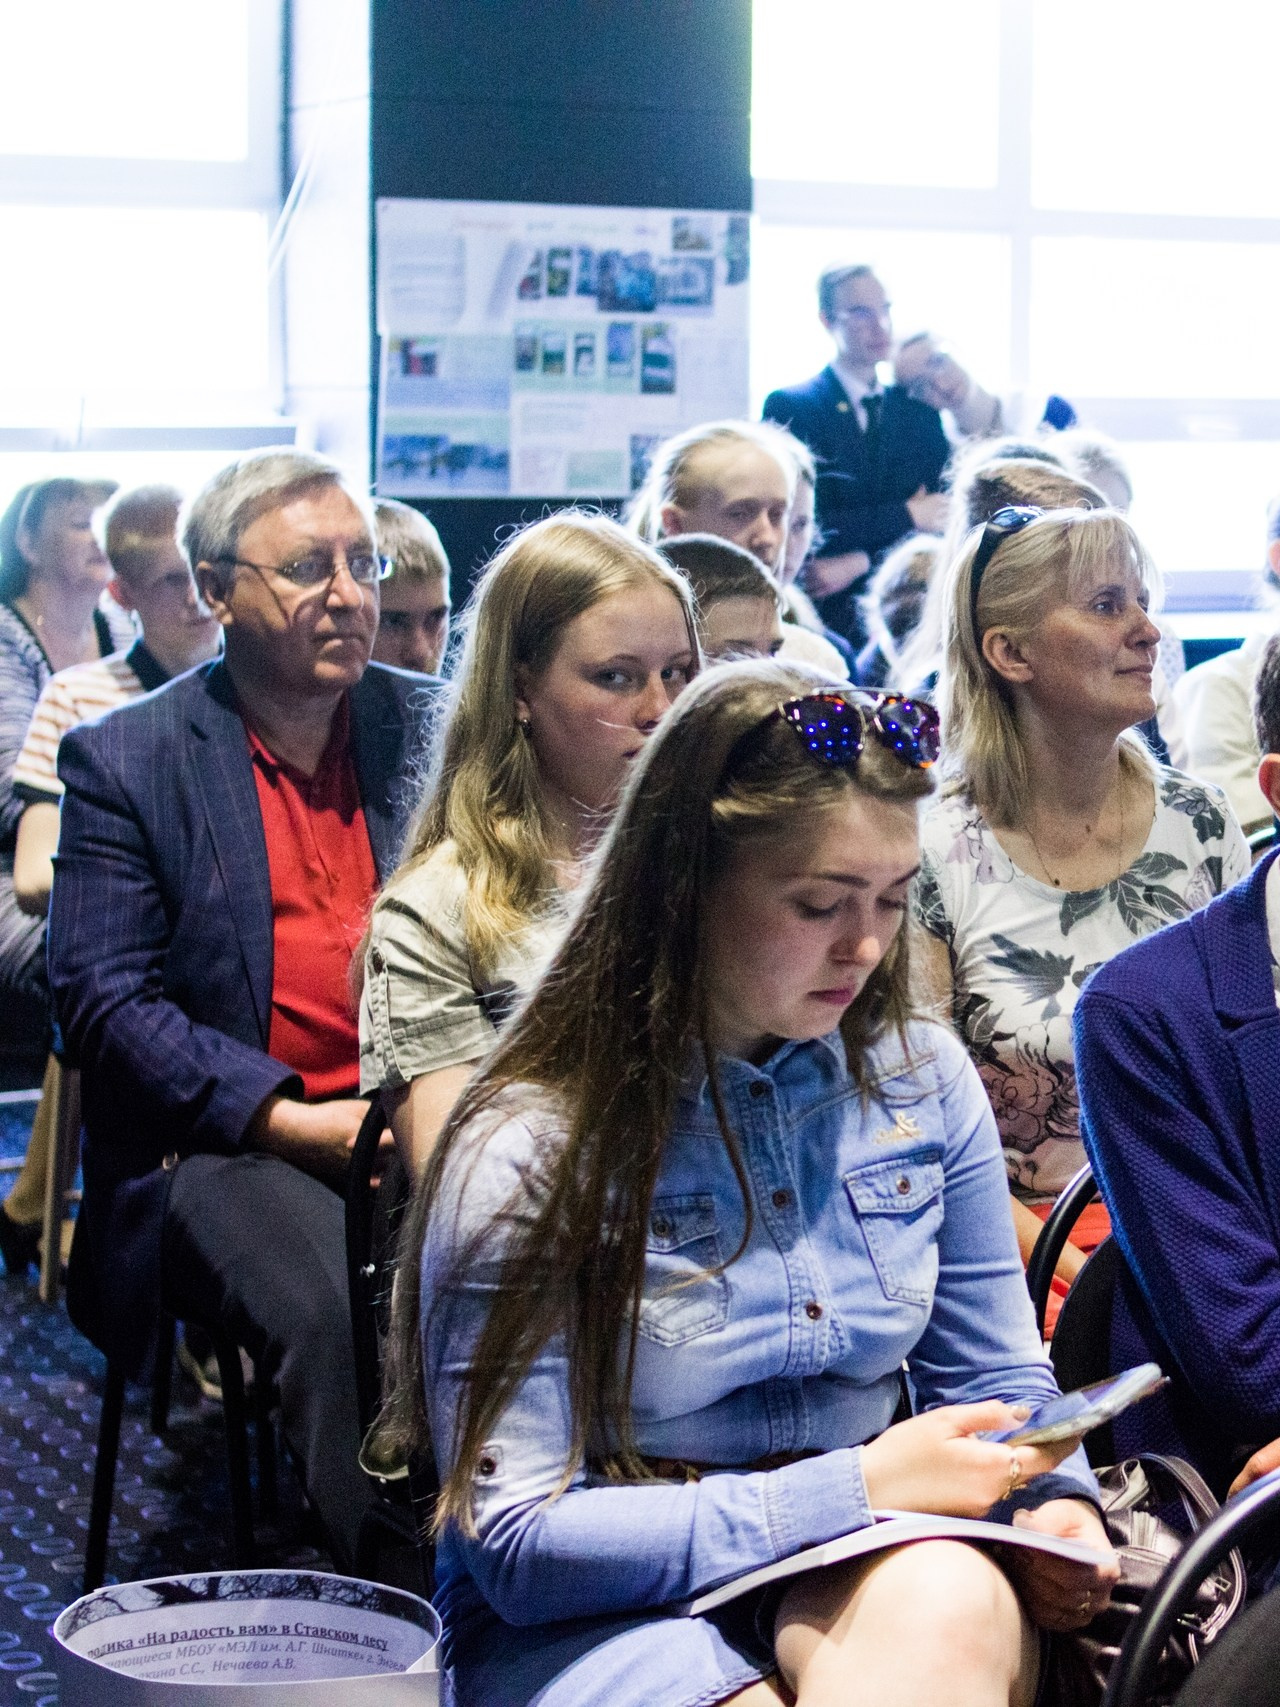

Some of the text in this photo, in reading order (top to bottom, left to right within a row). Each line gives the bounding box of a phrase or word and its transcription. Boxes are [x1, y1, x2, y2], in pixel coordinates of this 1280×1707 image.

[138, 1631, 166, 1645] «На
[170, 1625, 234, 1644] радость
[239, 1623, 278, 1636] вам»
[281, 1624, 290, 1635] в
[294, 1622, 359, 1643] Ставском
[362, 1635, 388, 1651] лесу
[176, 1643, 216, 1659] МБОУ
[212, 1659, 268, 1672] Нечаева
[272, 1658, 295, 1670] А.В.
